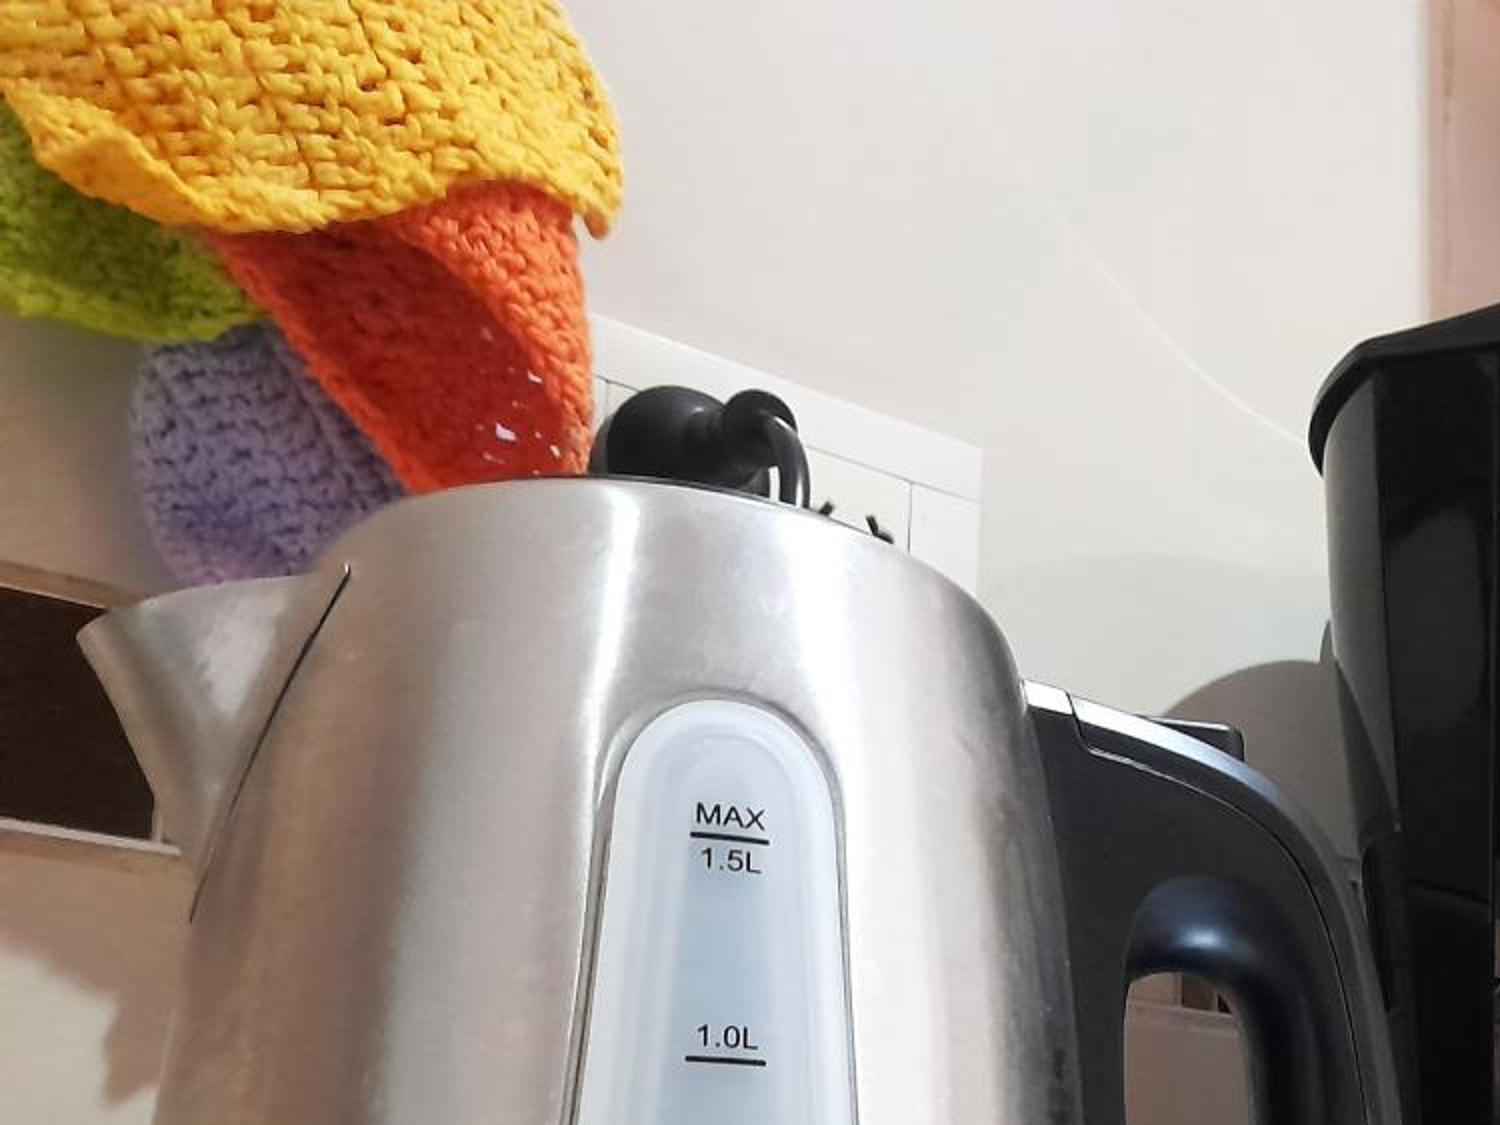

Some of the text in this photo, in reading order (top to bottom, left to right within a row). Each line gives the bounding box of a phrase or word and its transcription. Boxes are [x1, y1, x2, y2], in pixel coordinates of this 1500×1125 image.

[695, 803, 766, 831] MAX
[700, 847, 762, 875] 1.5L
[696, 1025, 759, 1052] 1.0L
